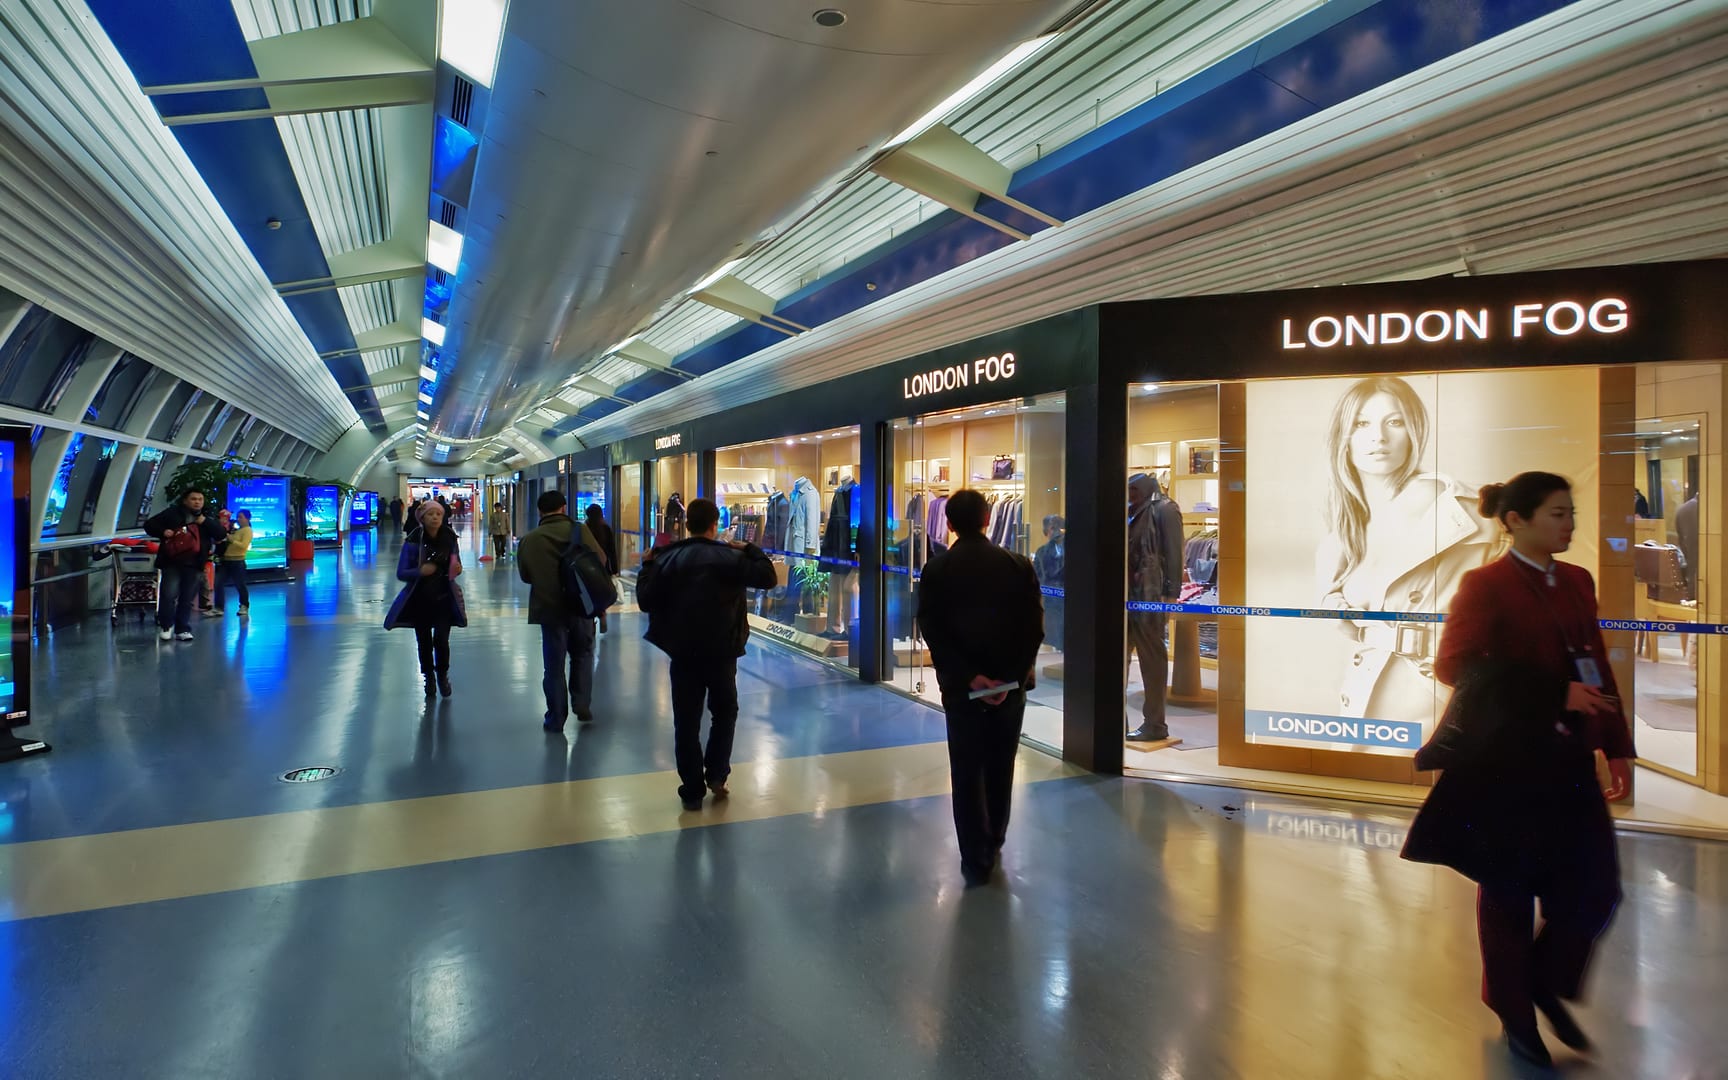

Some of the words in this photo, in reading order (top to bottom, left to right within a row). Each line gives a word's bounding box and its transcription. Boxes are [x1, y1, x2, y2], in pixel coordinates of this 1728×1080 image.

[1282, 308, 1488, 350] LONDON
[1512, 297, 1630, 338] FOG
[904, 363, 968, 399] LONDON
[974, 352, 1015, 385] FOG
[1128, 602, 1163, 611] LONDON
[1165, 604, 1184, 612] FOG
[1211, 606, 1248, 615] LONDON
[1251, 608, 1271, 616] FOG
[1300, 610, 1339, 618] LONDON
[1343, 611, 1364, 619] FOG
[1396, 613, 1438, 621] LONDON
[1599, 620, 1647, 630] LONDON
[1651, 622, 1676, 631] FOG
[1268, 716, 1358, 739] LONDON
[1363, 724, 1409, 743] FOG
